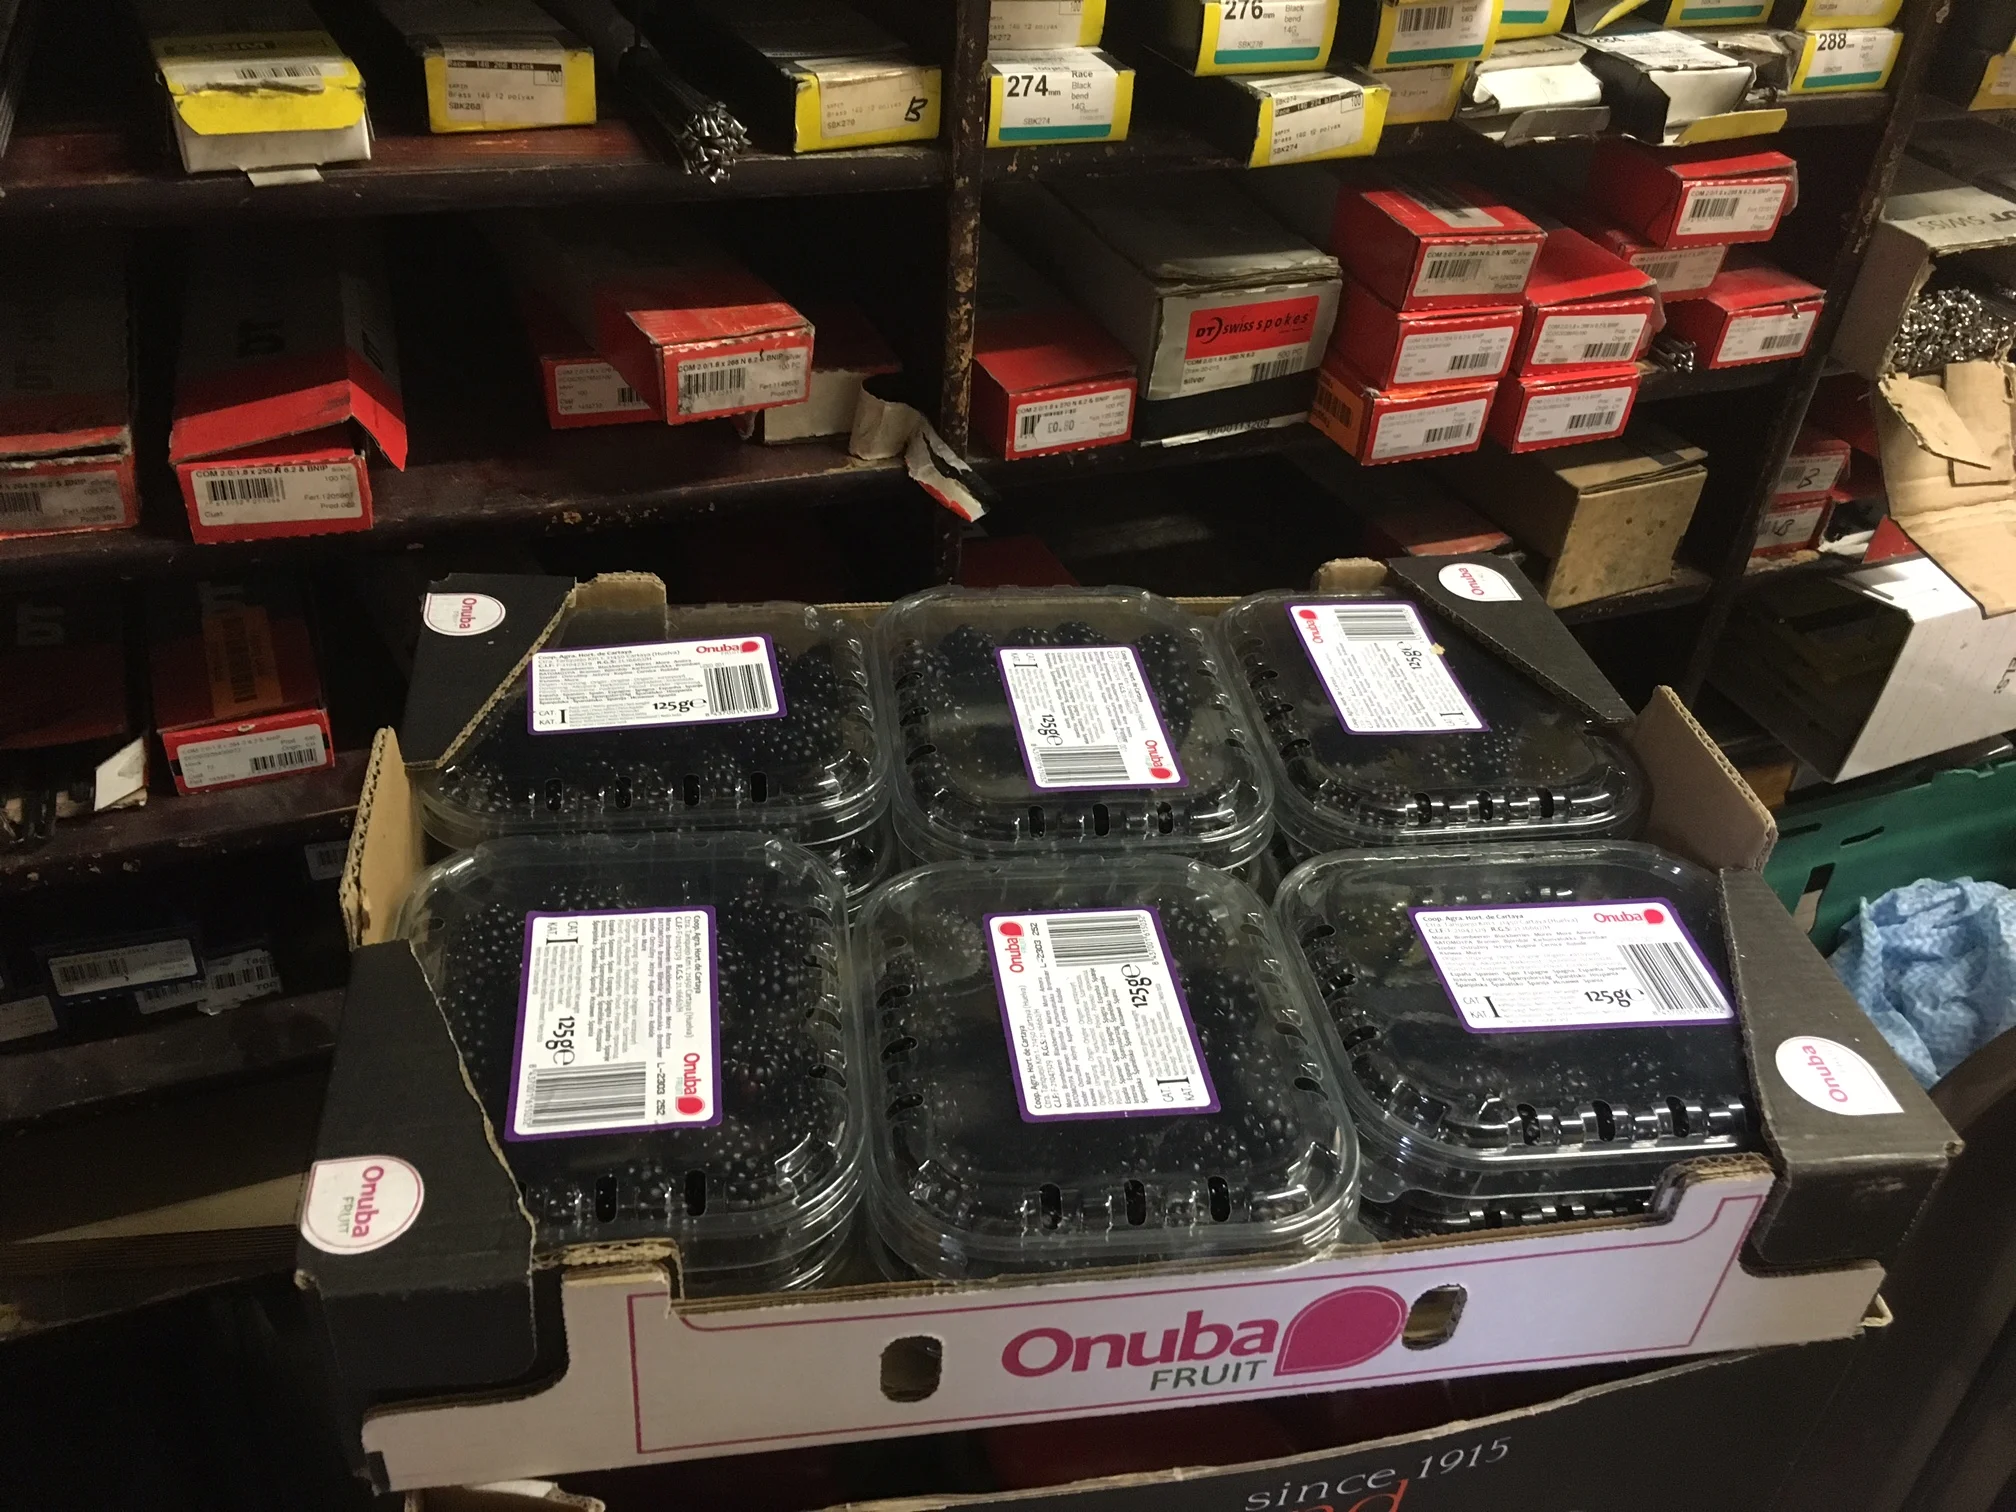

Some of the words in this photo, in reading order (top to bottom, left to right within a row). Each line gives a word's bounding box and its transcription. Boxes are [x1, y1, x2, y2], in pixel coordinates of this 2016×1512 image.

[1224, 0, 1263, 20] 276
[1285, 4, 1304, 12] Black
[1284, 15, 1301, 23] bend
[1817, 33, 1846, 51] 288
[512, 62, 534, 70] black
[1071, 70, 1093, 78] Race
[1007, 75, 1049, 98] 274
[1071, 81, 1091, 90] Black
[1071, 92, 1089, 100] bend
[1351, 95, 1362, 108] 100
[904, 95, 928, 122] B
[1071, 103, 1085, 111] 14G
[1023, 117, 1050, 125] SBK274
[1272, 143, 1298, 155] SBK274
[1917, 215, 1986, 232] SWISS
[1195, 326, 1216, 338] DT
[1222, 320, 1254, 335] swiss
[1256, 311, 1309, 332] spokes
[1183, 375, 1206, 385] silver
[195, 470, 218, 478] COM
[307, 464, 328, 473] BNIP
[1458, 567, 1485, 596] Onuba
[459, 597, 478, 629] Onuba
[1306, 620, 1323, 643] Onuba
[695, 643, 739, 653] Onuba
[653, 699, 690, 712] 125g
[559, 709, 566, 723] I
[1037, 714, 1059, 735] 125g
[1144, 739, 1163, 767] Onuba
[692, 915, 700, 930] Coop.
[1593, 911, 1643, 922] Onuba
[546, 921, 557, 936] KAT.
[567, 920, 578, 935] CAT.
[1029, 922, 1039, 935] 252
[545, 936, 578, 945] I
[692, 932, 701, 947] Agra.
[1004, 937, 1024, 972] Onuba
[1033, 939, 1046, 968] L-2303
[693, 971, 702, 993] Cartaya
[684, 988, 692, 1010] Cartaya
[1018, 984, 1031, 1008] (Huelva)
[1125, 976, 1151, 1007] 125g
[1584, 989, 1630, 1007] 125g
[1484, 996, 1500, 1017] I
[684, 1011, 693, 1038] (Huelva)
[1024, 1009, 1034, 1030] Cartaya
[545, 1015, 574, 1049] 125g
[1019, 1024, 1029, 1047] Cartaya
[1023, 1048, 1030, 1056] de
[1025, 1057, 1033, 1072] Hort.
[656, 1062, 664, 1094] L-2303
[683, 1052, 701, 1095] Onuba
[1029, 1074, 1039, 1090] Agra.
[1155, 1076, 1189, 1085] I
[1802, 1045, 1848, 1103] Onuba
[1033, 1091, 1042, 1108] Coop.
[1160, 1086, 1174, 1102] CAT.
[1180, 1085, 1194, 1100] KAT.
[656, 1099, 664, 1115] 252
[351, 1166, 384, 1238] Onuba
[338, 1196, 354, 1234] FRUIT
[1001, 1309, 1279, 1377] Onuba
[1149, 1360, 1267, 1391] FRUIT
[1245, 1467, 1396, 1512] since
[1415, 1436, 1512, 1480] 1915
